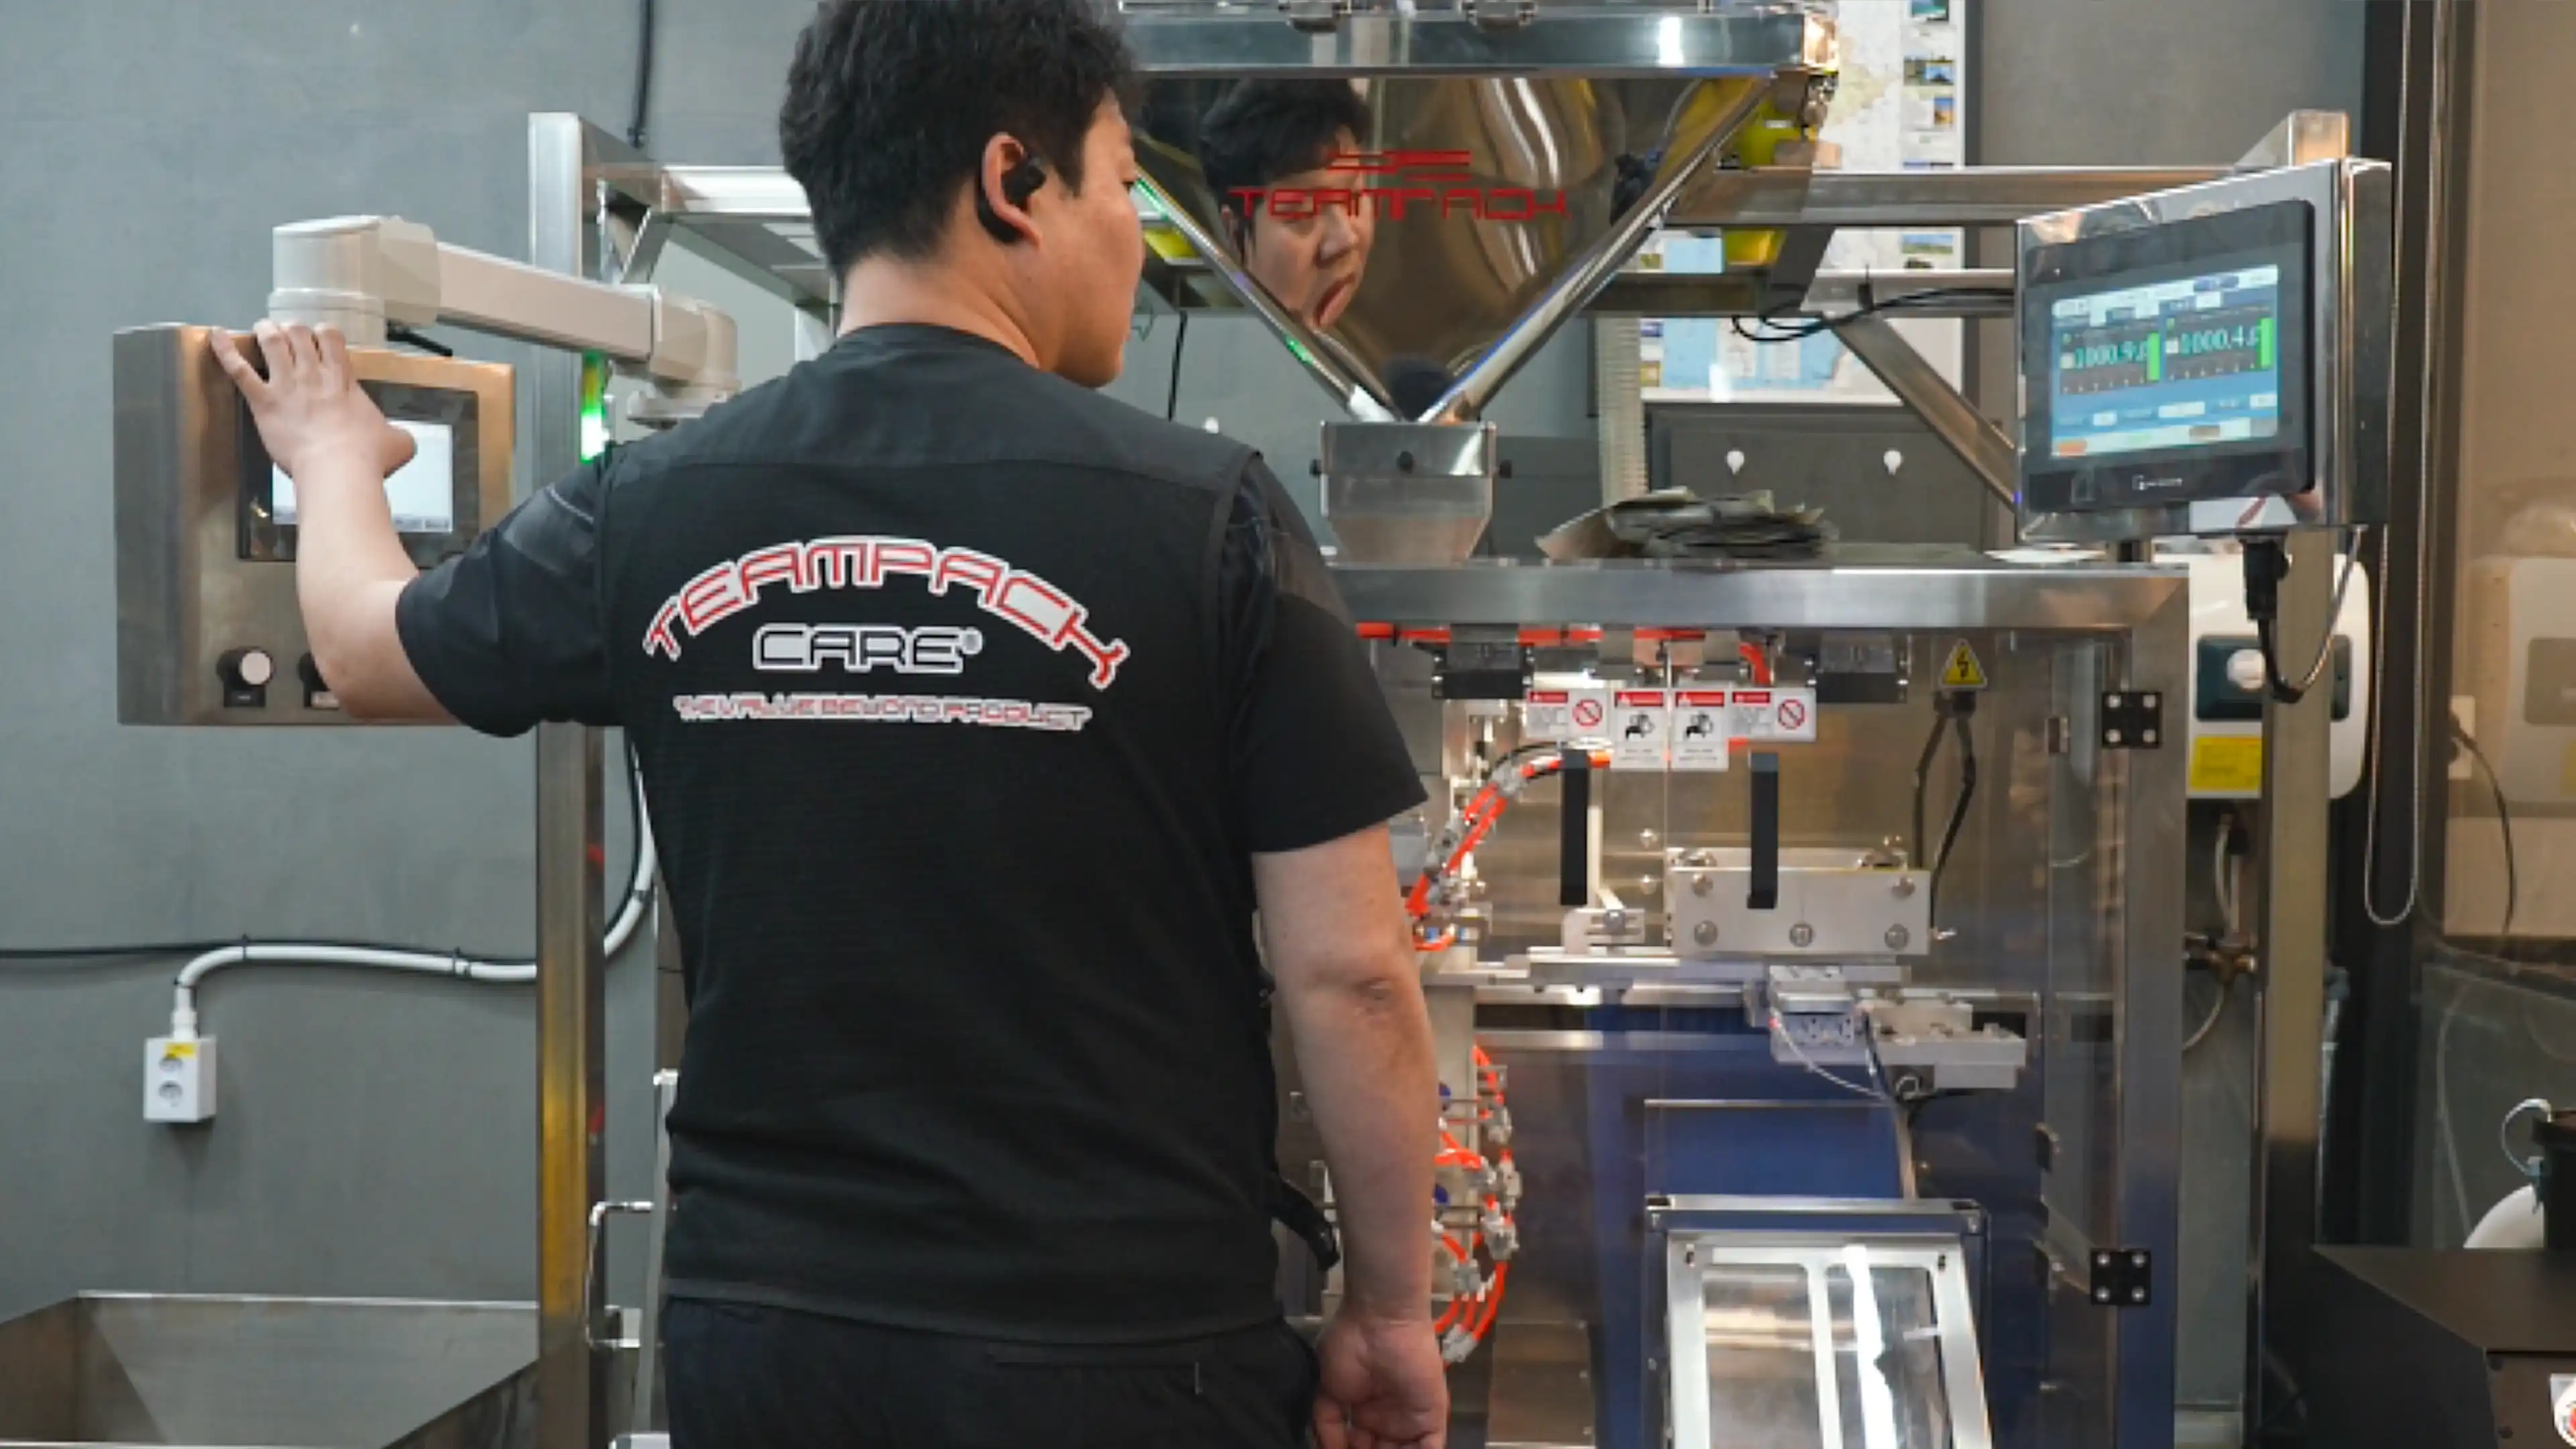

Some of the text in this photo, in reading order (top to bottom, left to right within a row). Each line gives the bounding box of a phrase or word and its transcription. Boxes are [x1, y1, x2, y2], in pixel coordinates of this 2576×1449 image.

[1228, 186, 1574, 220] TEAMPACK
[643, 536, 1131, 688] TEAMPACK
[718, 692, 815, 720] VALUE
[818, 694, 941, 722] BEYOND
[943, 695, 1093, 731] PRODUCT
